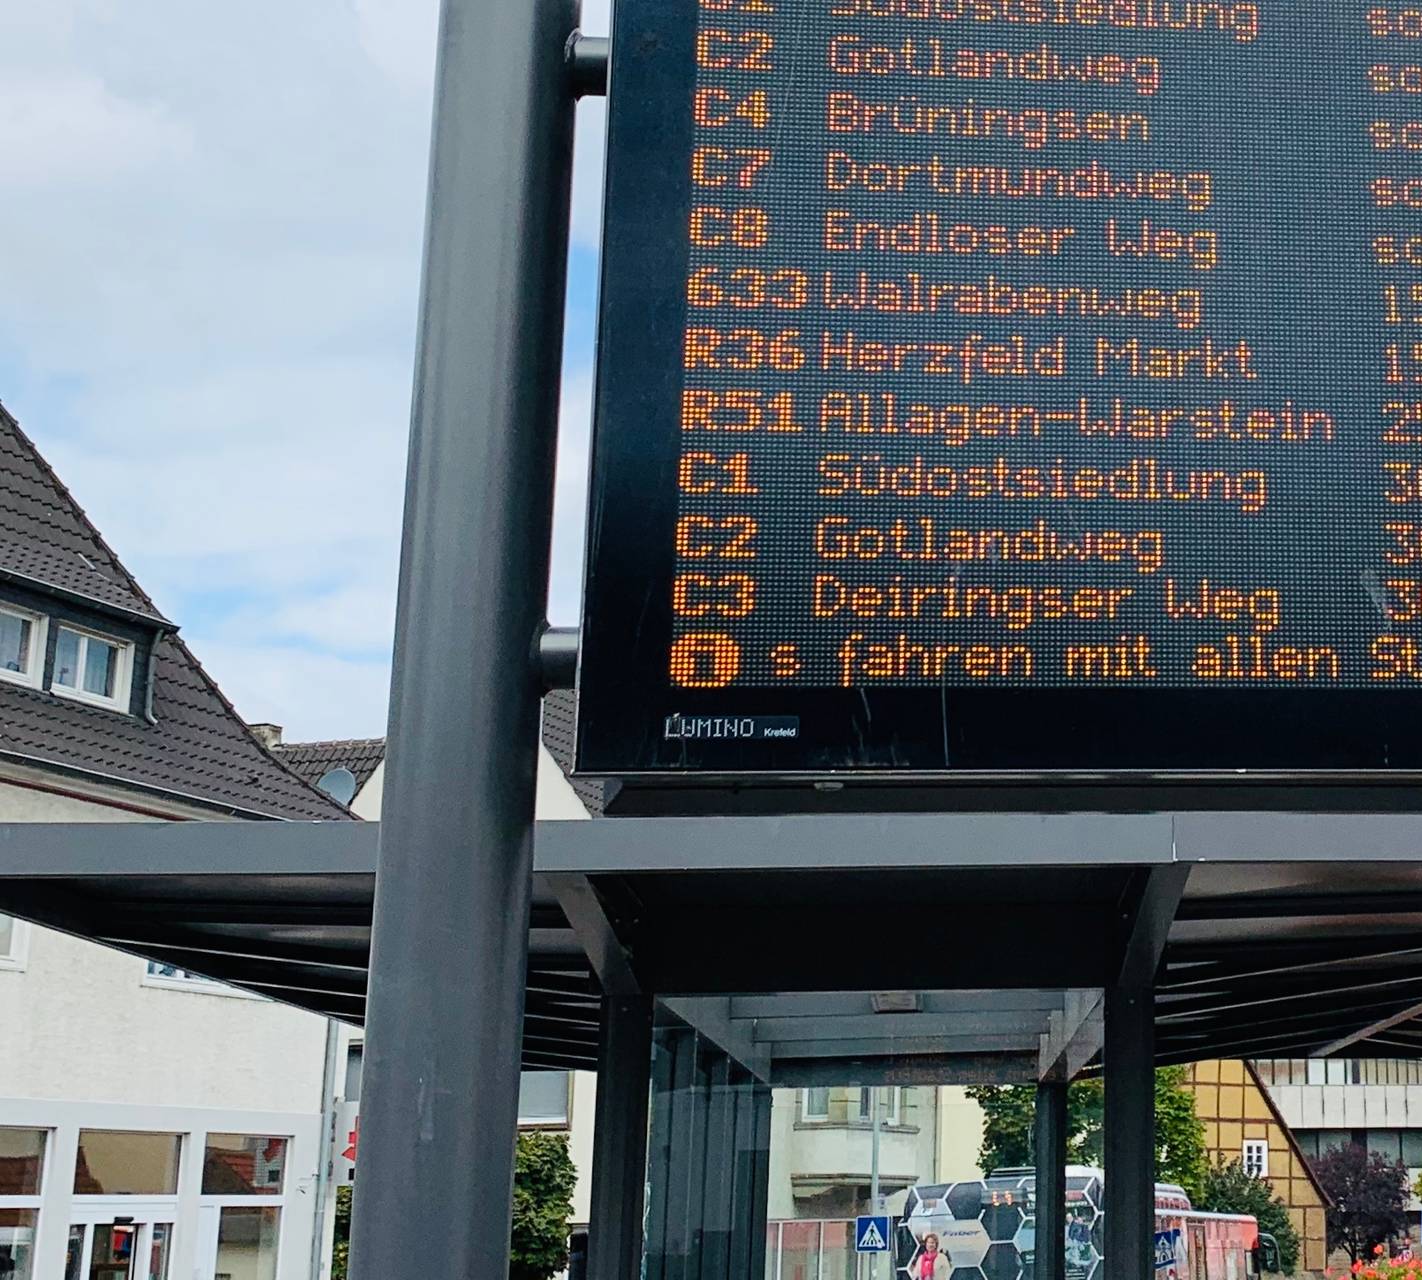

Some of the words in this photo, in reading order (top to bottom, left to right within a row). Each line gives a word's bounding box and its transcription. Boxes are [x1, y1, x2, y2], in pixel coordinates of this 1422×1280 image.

[697, 30, 774, 71] C2
[830, 35, 1161, 95] Gotlandweg
[695, 88, 771, 130] C4
[829, 92, 1150, 149] Brüningsen
[692, 148, 772, 189] C7
[828, 151, 1212, 211] Dortmundweg
[690, 207, 769, 249] C8
[826, 211, 1076, 256] Endloser
[1108, 219, 1219, 270] Weg
[688, 267, 809, 310] 633
[824, 271, 1203, 329] Walrabenweg
[684, 329, 806, 371] R36
[822, 331, 1065, 385] Herzfeld
[1095, 338, 1259, 380] Markt
[681, 390, 804, 434] R51
[820, 392, 1335, 447] Allagen-Warstein
[678, 452, 760, 496] C1
[818, 453, 1268, 513] Südostsiedlung
[675, 514, 760, 560] C2
[815, 515, 1164, 574] Gotlandweg
[673, 573, 758, 619] C3
[813, 574, 1134, 631] Deiringser
[1166, 579, 1280, 632] Weg
[838, 631, 1035, 689] fahren
[1065, 634, 1158, 680] mit
[1191, 635, 1341, 680] allen
[665, 717, 755, 739] LUMINO
[763, 727, 797, 738] Krefeld
